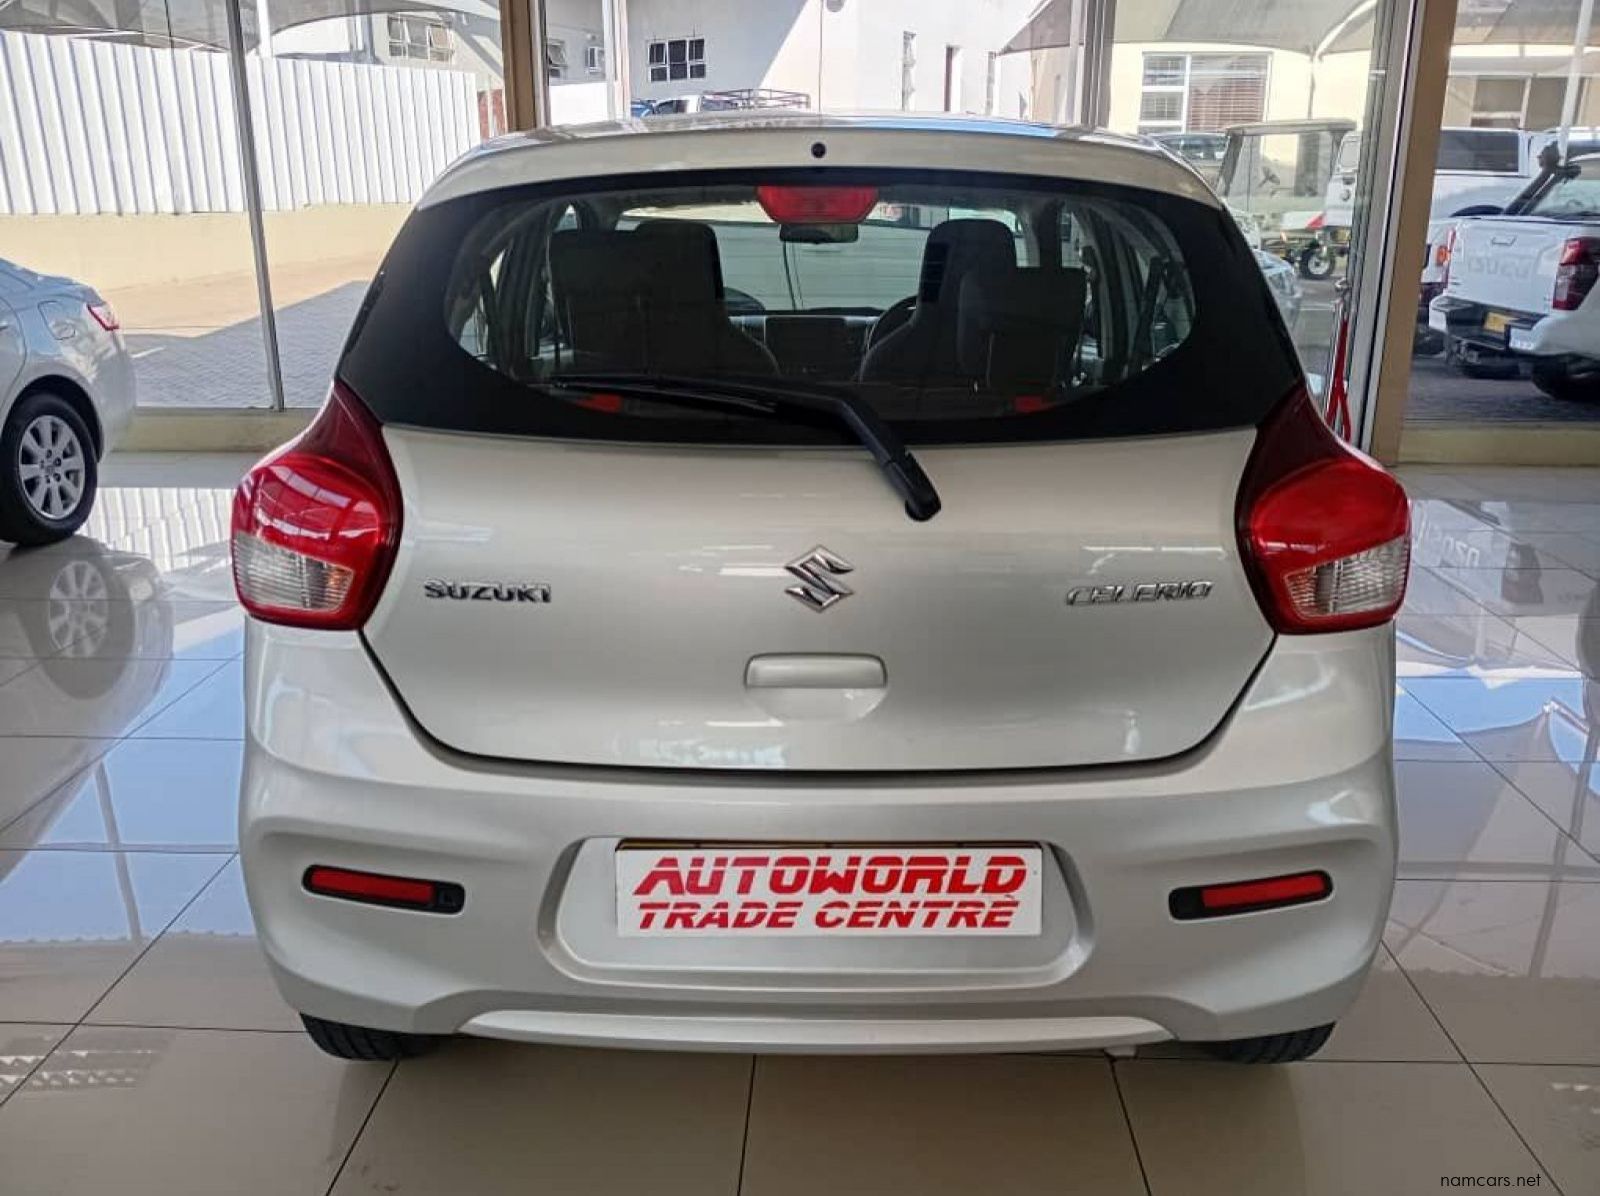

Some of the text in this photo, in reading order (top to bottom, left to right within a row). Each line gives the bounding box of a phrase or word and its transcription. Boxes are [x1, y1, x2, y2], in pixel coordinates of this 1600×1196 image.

[424, 580, 551, 603] SUZUKI
[1066, 580, 1214, 606] CELERIO
[633, 856, 1027, 895] AUTOWORLD
[639, 901, 803, 929] TRADE
